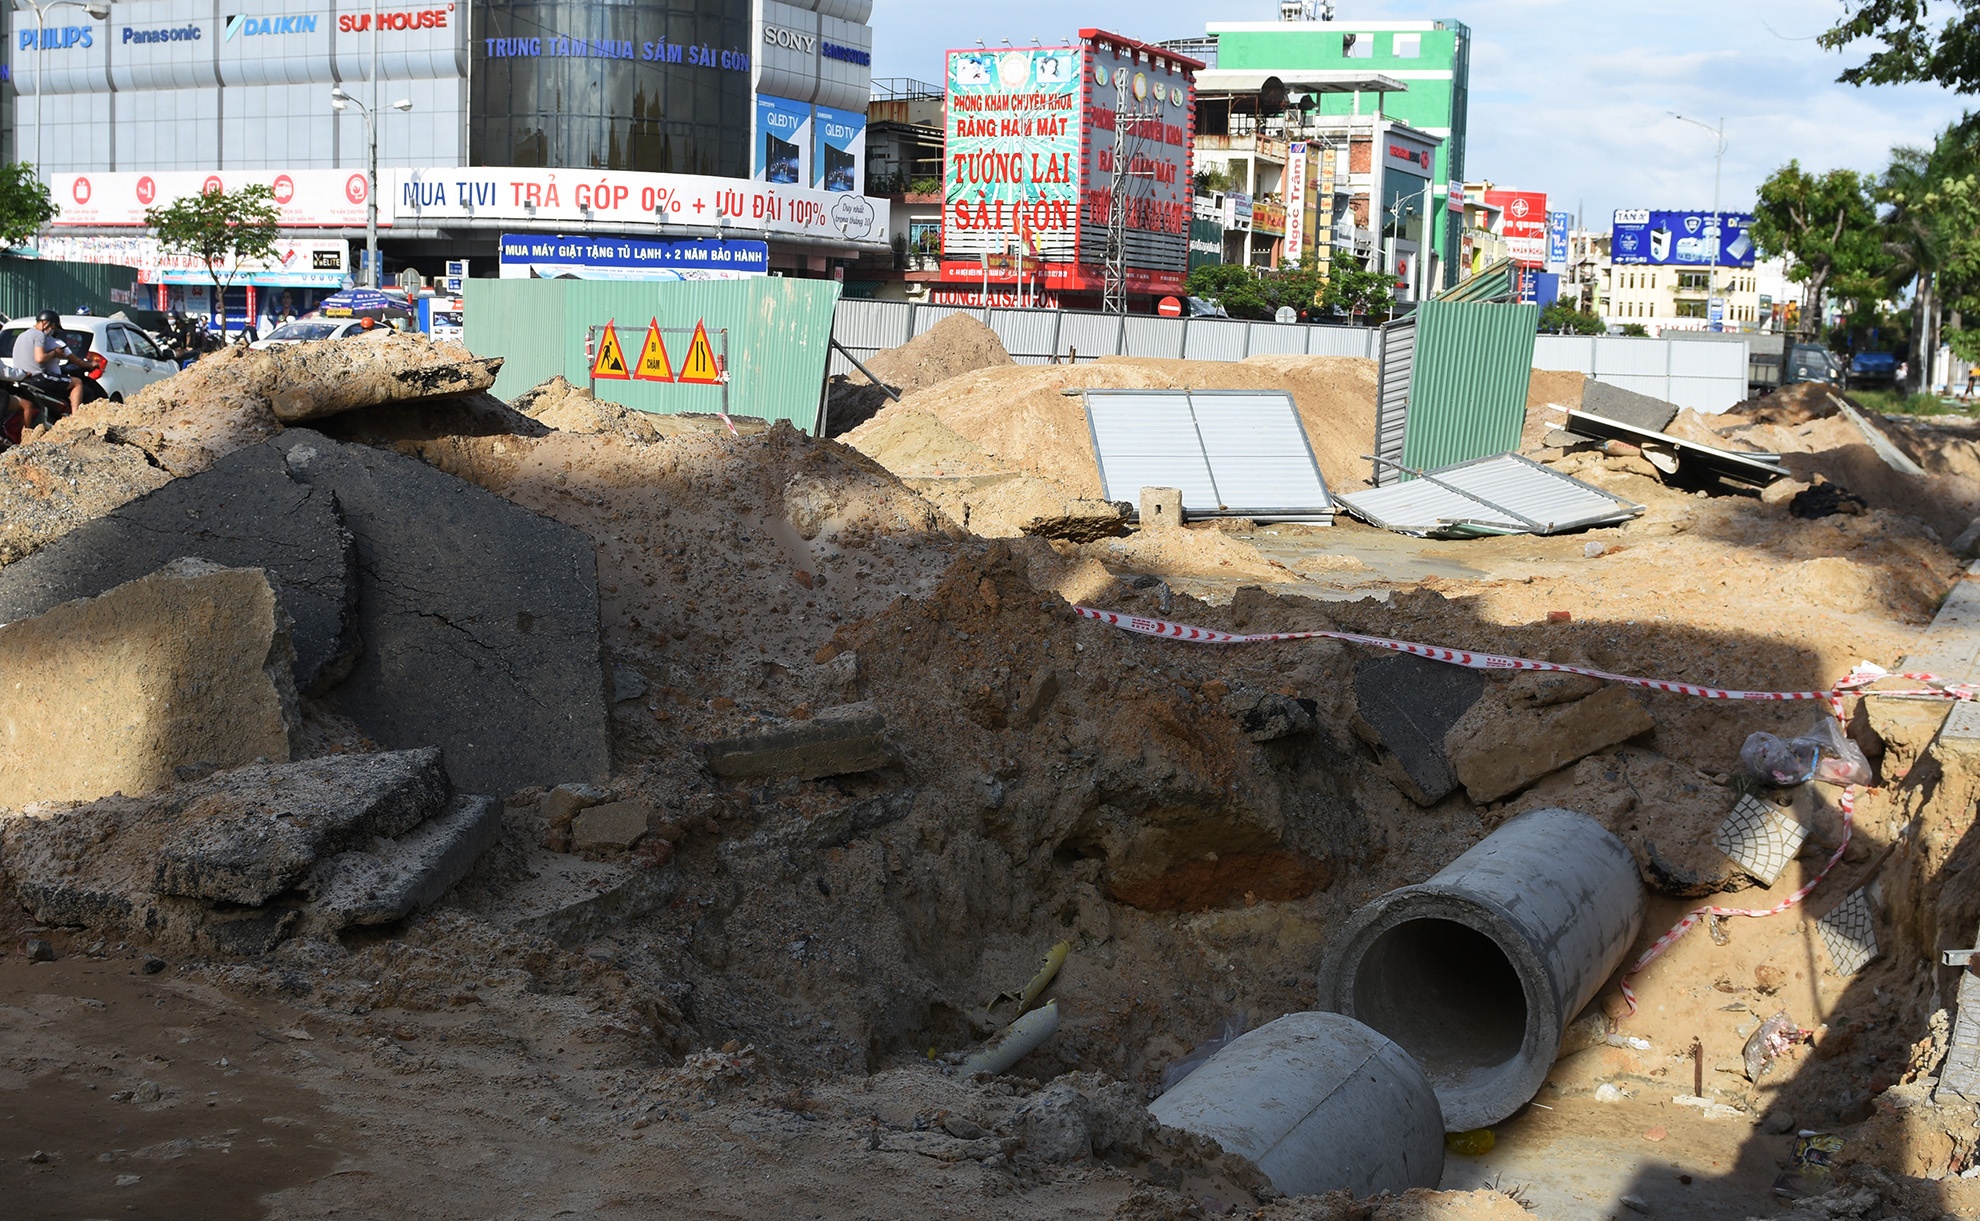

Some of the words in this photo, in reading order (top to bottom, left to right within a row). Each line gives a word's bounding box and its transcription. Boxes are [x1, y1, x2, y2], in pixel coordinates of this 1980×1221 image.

[243, 15, 317, 36] DAIKIN
[339, 10, 447, 33] SUNHOUSE
[19, 26, 93, 50] PHILIPS
[122, 24, 201, 44] Panasonic
[764, 26, 815, 53] SONY
[486, 38, 541, 58] TRUNG
[548, 33, 587, 58] TÂM
[593, 38, 634, 59] MUA
[641, 35, 682, 64] SẮM
[688, 43, 716, 68] SÀI
[721, 45, 750, 72] GÒN
[822, 42, 871, 67] SAMSUNG
[953, 90, 982, 112] PHÒNG
[985, 90, 1009, 111] KHÁM
[1011, 90, 1046, 111] CHUYÊN
[1048, 93, 1072, 111] KHOA
[767, 112, 789, 128] QLED
[788, 116, 799, 129] TV
[825, 123, 844, 138] QLED
[844, 126, 854, 139] TV
[957, 115, 996, 137] RĂNG
[1037, 113, 1068, 141] MẶT
[953, 148, 1022, 184] TƯƠNG
[1031, 152, 1070, 183] LAI
[1291, 158, 1301, 203] Trâm
[403, 182, 446, 206] MUA
[456, 182, 496, 206] TIVI
[510, 174, 560, 208] TRẢ
[575, 178, 629, 210] GÓP
[642, 186, 681, 212] 0%
[692, 198, 705, 214] +
[716, 188, 744, 217] ƯU
[753, 190, 782, 221] ĐÃI
[788, 198, 825, 226] 100%
[955, 190, 1003, 230] SÀI
[1013, 190, 1070, 231] GÒN
[1288, 208, 1301, 252] Ngọc
[323, 258, 340, 267] ELITE
[505, 245, 529, 256] MUA
[532, 243, 555, 257] MÁY
[558, 244, 583, 259] GIẶT
[586, 244, 614, 259] TẶNG
[617, 244, 630, 258] TỦ
[634, 247, 661, 261] LẠNH
[664, 251, 672, 259] +
[674, 249, 681, 260] 2
[684, 247, 708, 260] NĂM
[711, 247, 731, 261] BẢO
[734, 249, 762, 262] HÀNH
[646, 357, 660, 371] CHẬM
